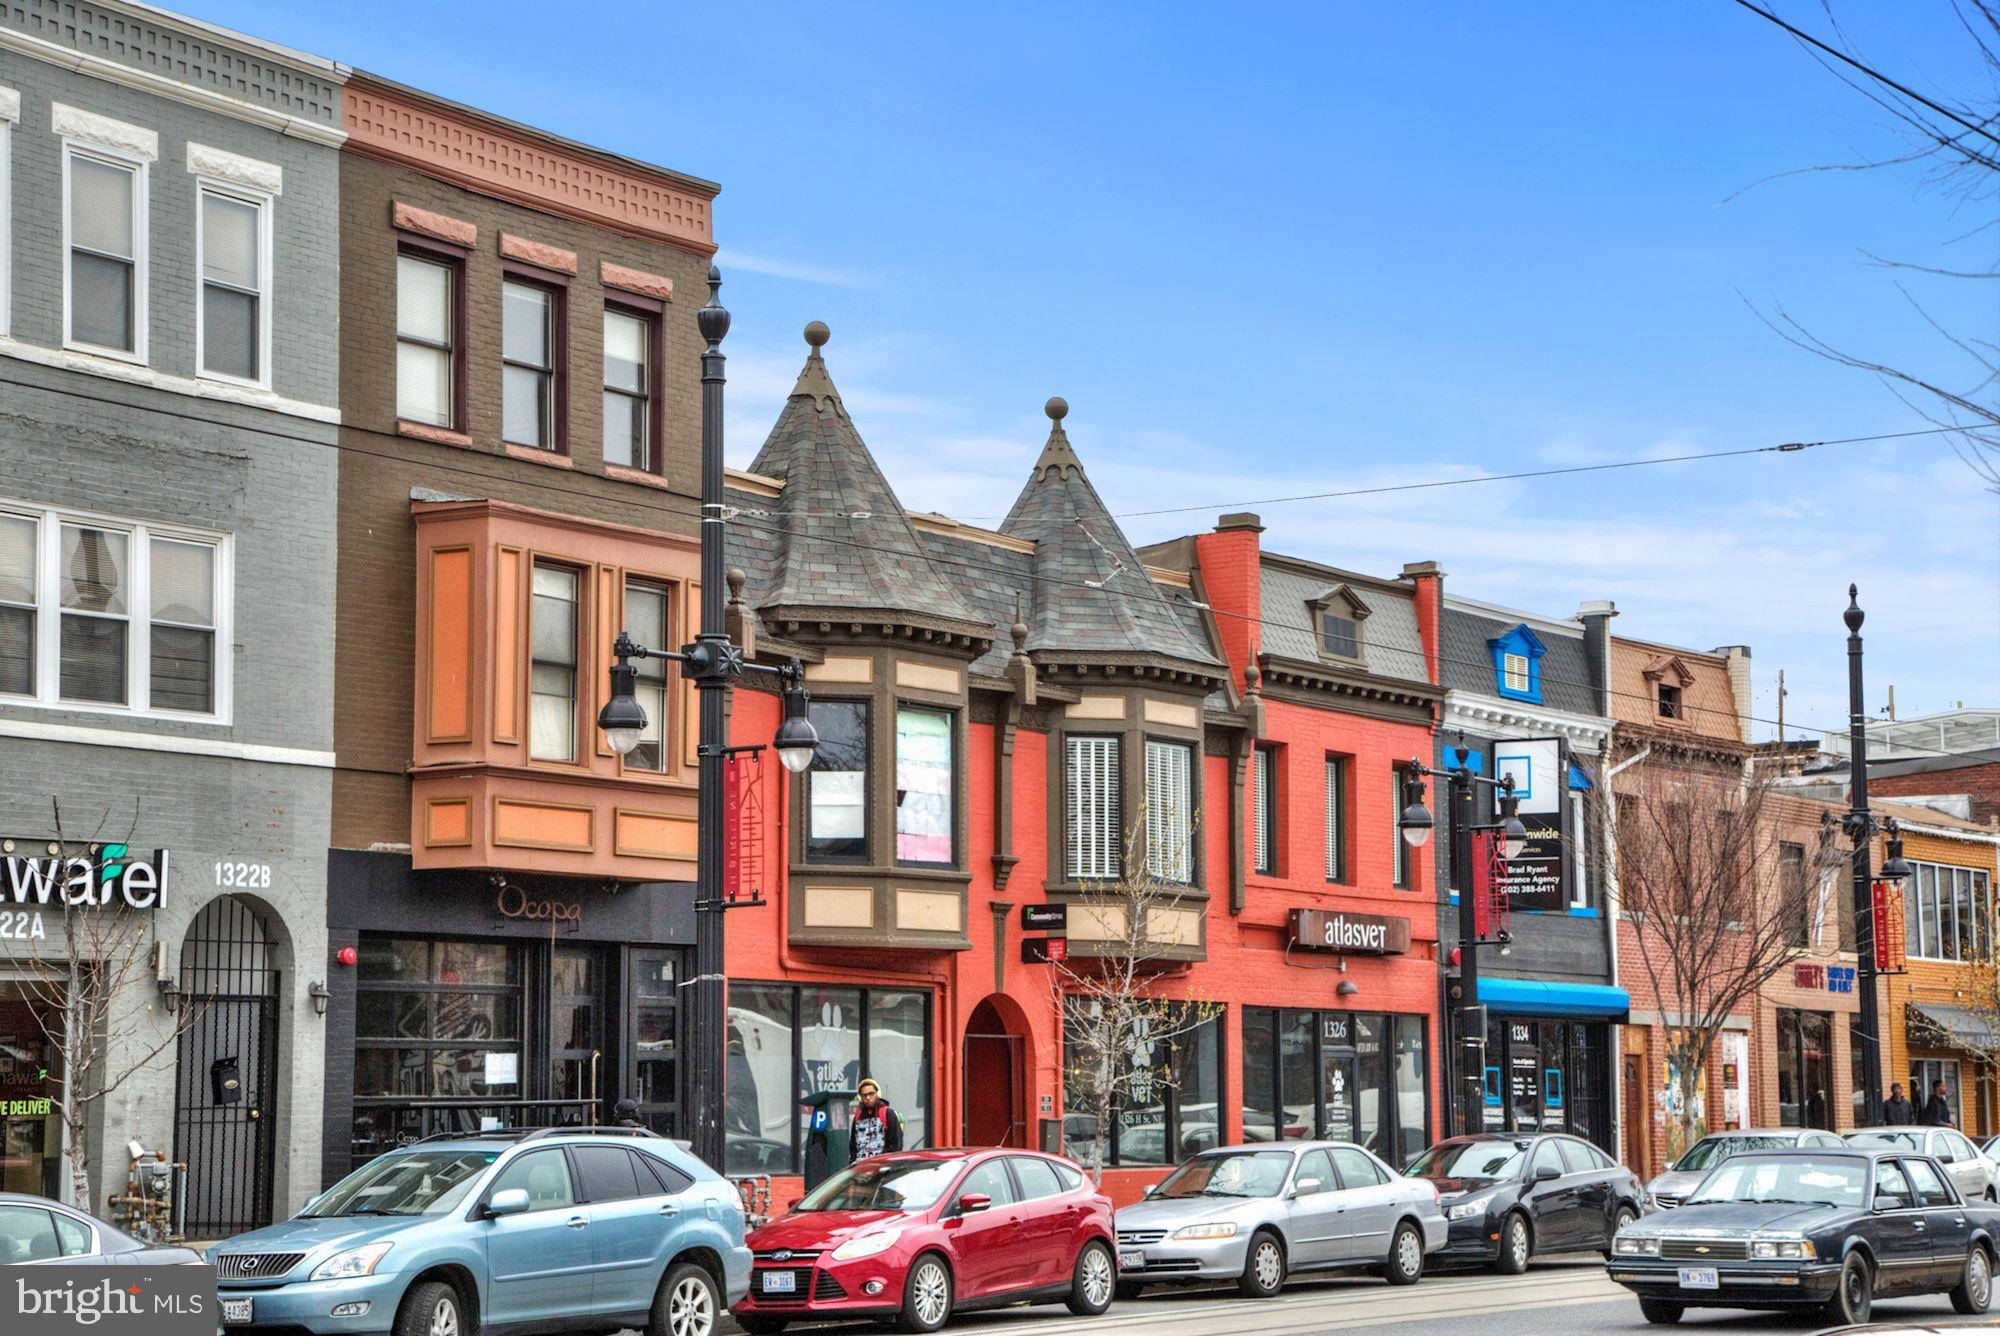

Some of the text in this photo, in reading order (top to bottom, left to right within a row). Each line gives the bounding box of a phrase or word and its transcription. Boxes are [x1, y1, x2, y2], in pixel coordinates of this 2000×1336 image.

[0, 844, 170, 908] wafel
[214, 861, 272, 888] 1322B
[1507, 866, 1549, 875] Brad Ryant
[1531, 876, 1561, 885] Agency
[1323, 1021, 1347, 1038] 1326
[1512, 1024, 1529, 1041] 1334
[816, 1061, 845, 1082] atlas
[10, 1100, 51, 1115] DELIVER
